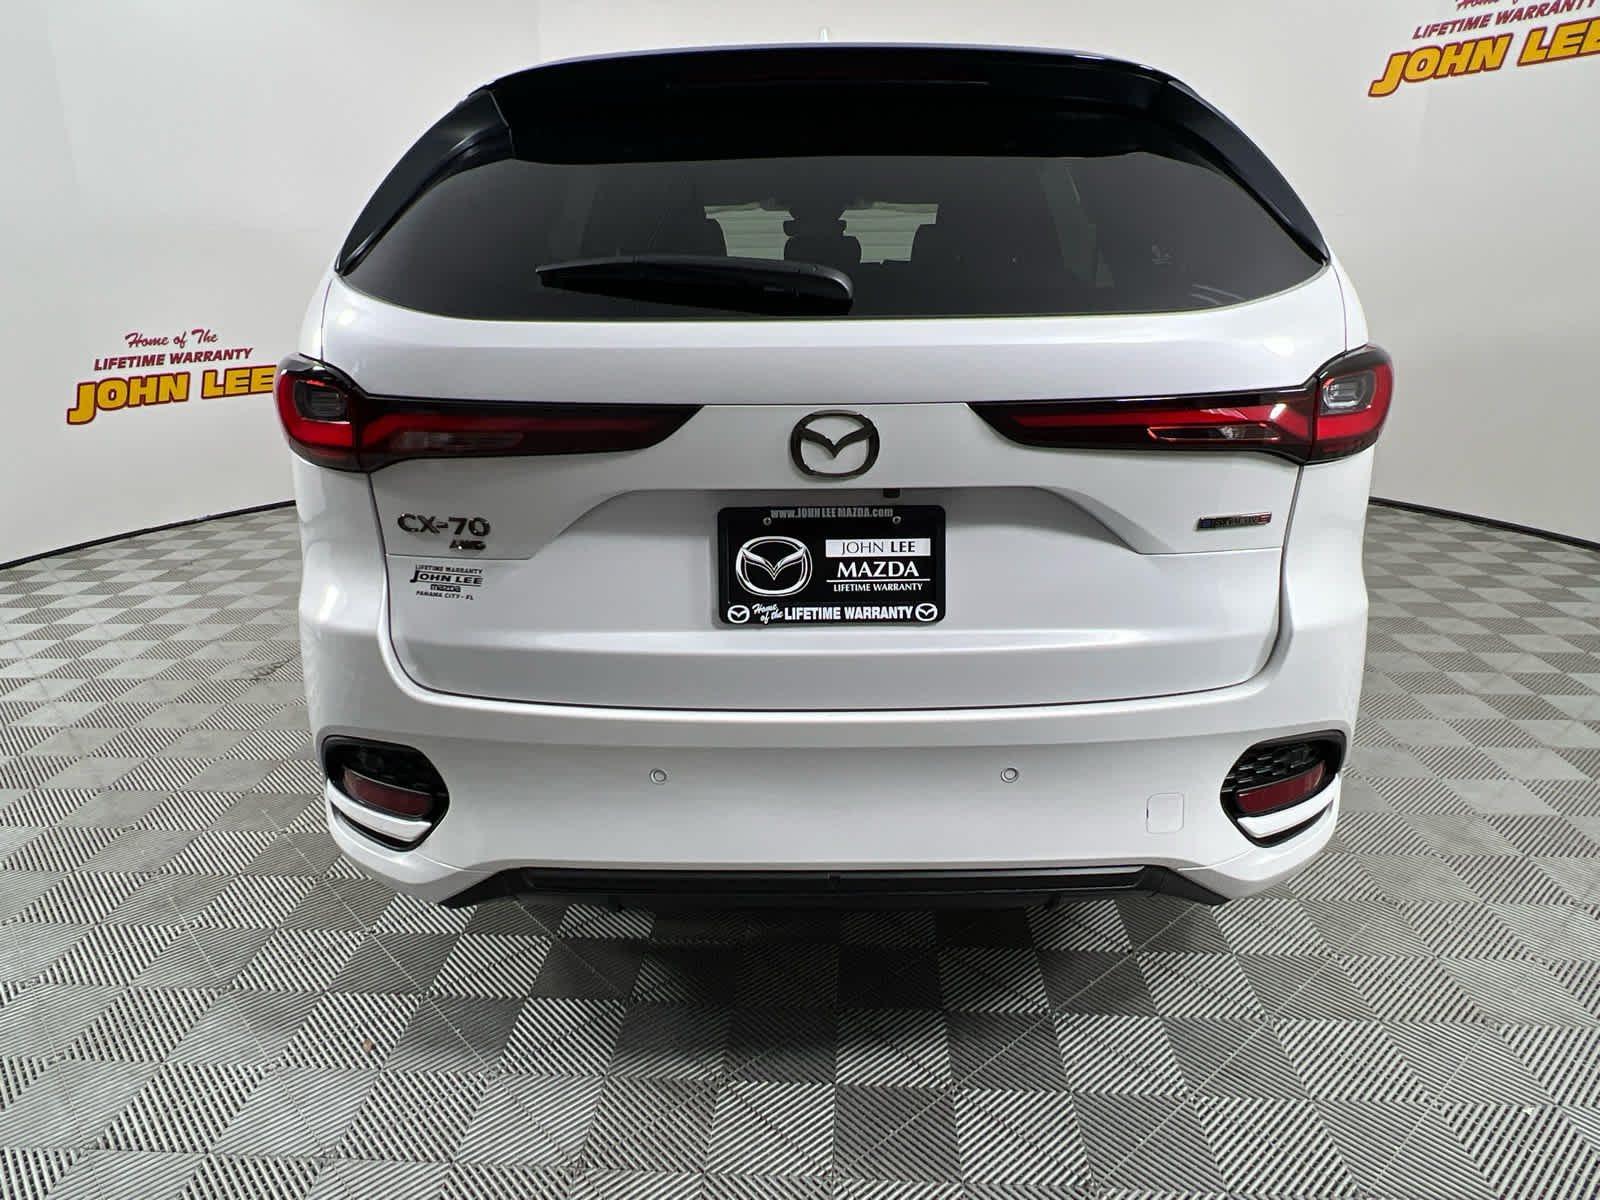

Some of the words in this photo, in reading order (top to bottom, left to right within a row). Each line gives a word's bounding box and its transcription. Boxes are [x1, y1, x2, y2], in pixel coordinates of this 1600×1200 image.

[1412, 13, 1493, 40] LIFETIME
[1367, 33, 1514, 97] JOHN
[125, 332, 169, 348] Home
[173, 333, 187, 348] of
[191, 328, 218, 343] The
[94, 353, 165, 371] LIFETIME
[169, 348, 253, 364] WARRANTY
[66, 371, 191, 425] JOHN
[201, 364, 277, 399] LEE
[397, 513, 490, 537] CX-70
[842, 542, 884, 554] JOHN
[890, 541, 916, 553] LEE
[409, 570, 451, 583] JOHN
[455, 576, 484, 585] LEE
[837, 561, 919, 578] MAZDA
[833, 584, 871, 592] LIFETIME
[873, 583, 923, 591] WARRANTY
[784, 607, 841, 620] LIFETIME
[844, 606, 913, 620] WARRANTY
